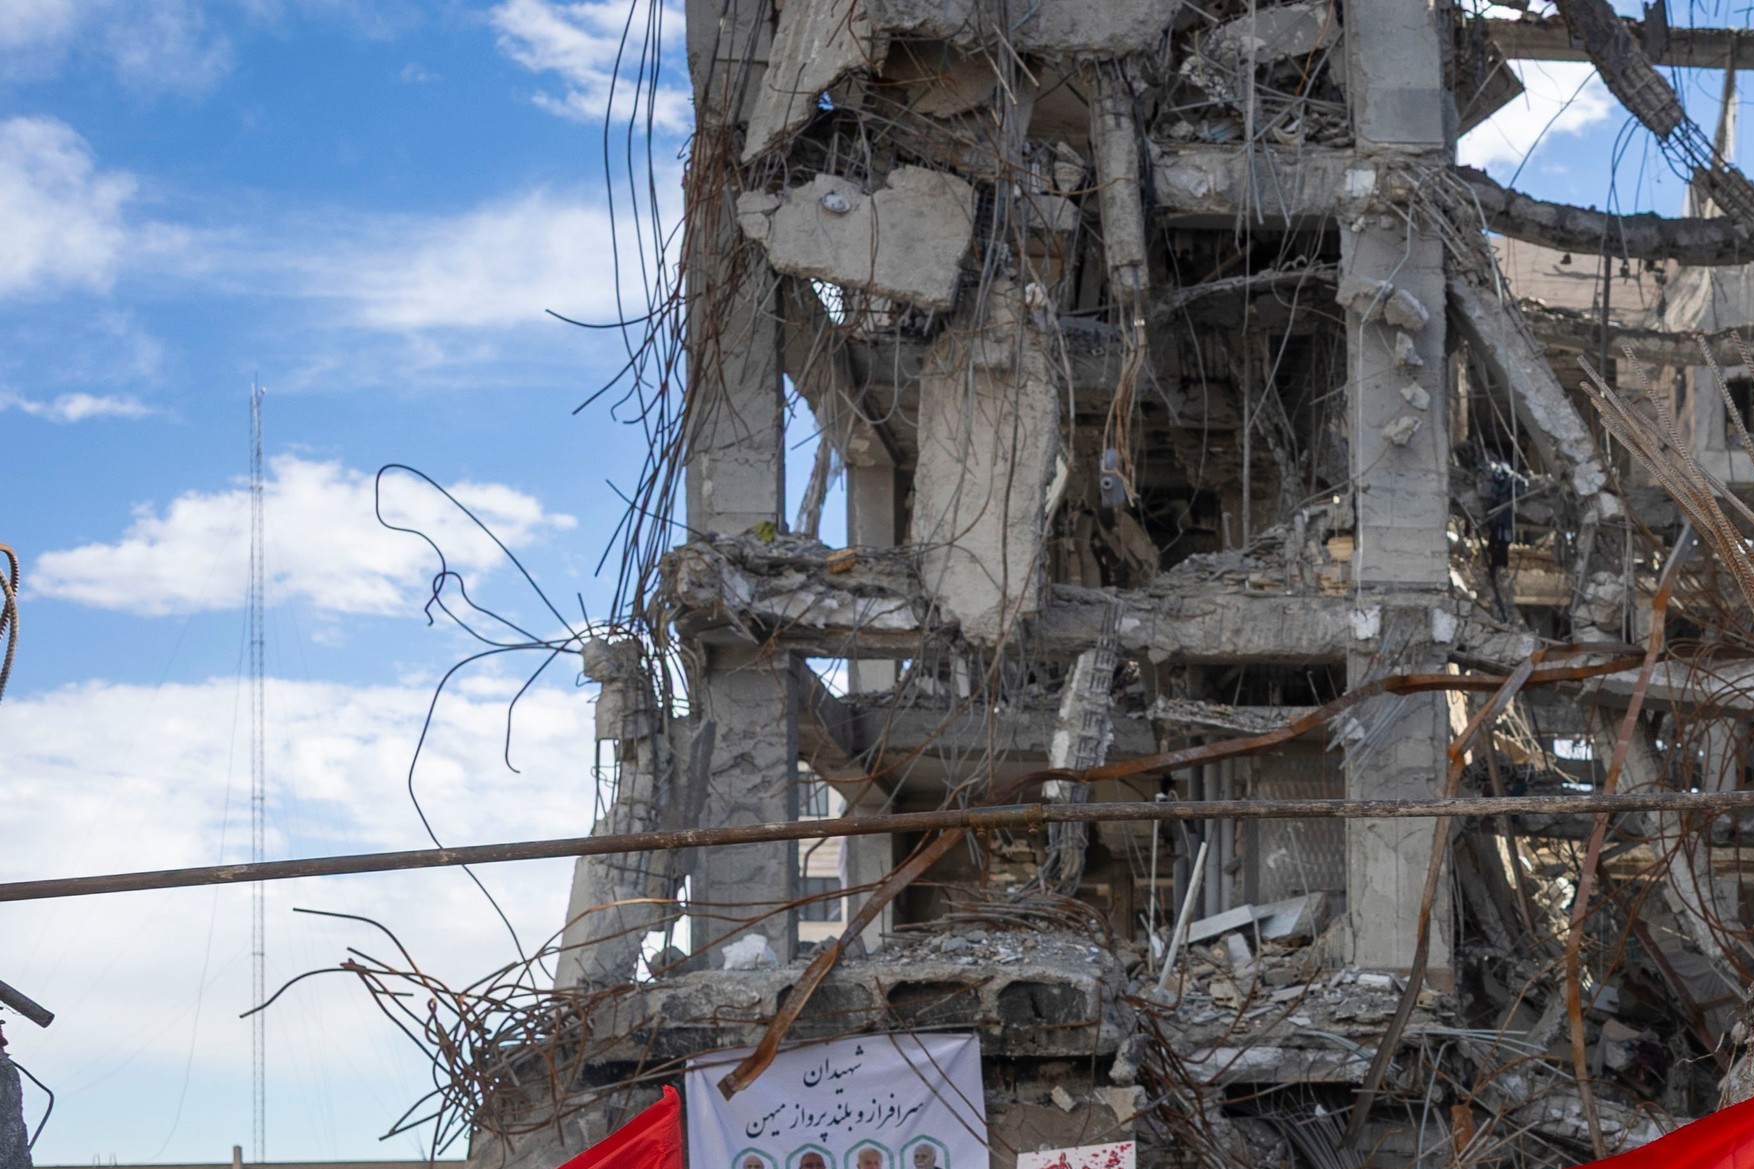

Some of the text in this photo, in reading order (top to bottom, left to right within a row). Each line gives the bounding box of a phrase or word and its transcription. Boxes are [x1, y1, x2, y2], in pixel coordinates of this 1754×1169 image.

[803, 1044, 865, 1095] شهیدان
[745, 1103, 787, 1139] میهن
[855, 1109, 865, 1124] و
[867, 1093, 925, 1130] سرافراز
